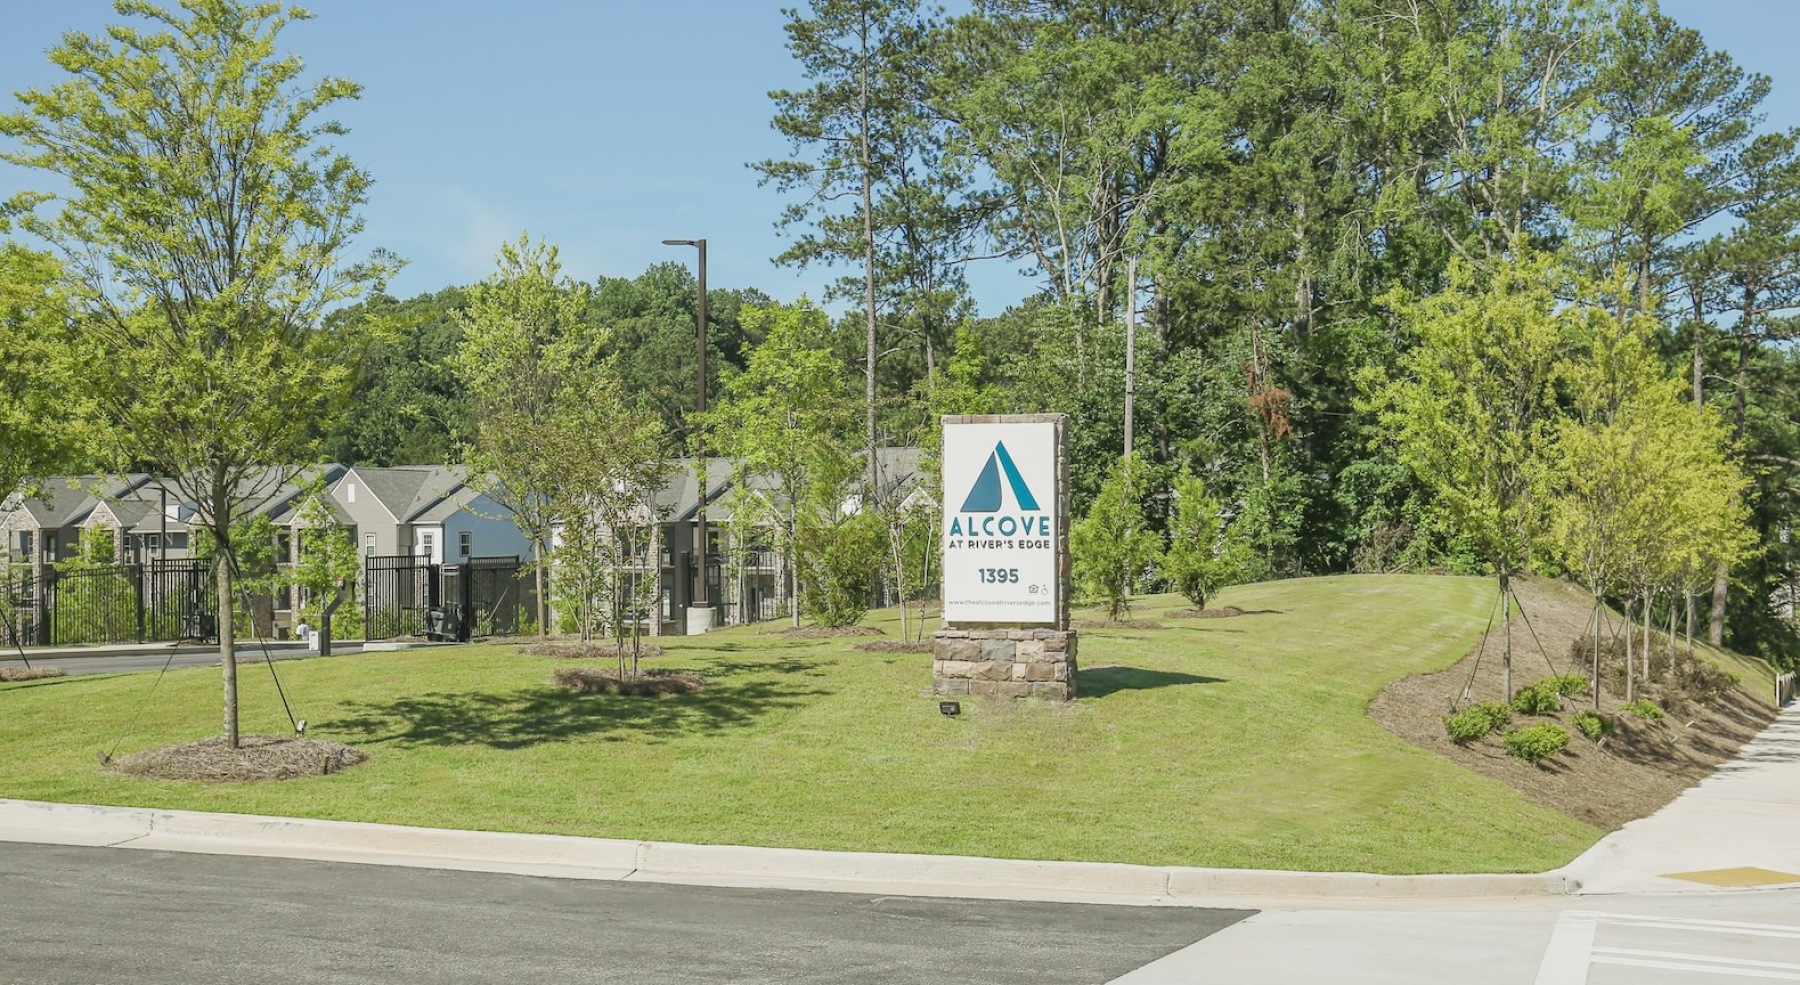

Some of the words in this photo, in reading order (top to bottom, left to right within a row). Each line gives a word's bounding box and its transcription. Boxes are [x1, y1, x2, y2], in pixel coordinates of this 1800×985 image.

[949, 516, 1050, 537] ALCOVE
[949, 540, 963, 549] AT
[968, 540, 1014, 549] RIVER'S
[1018, 540, 1050, 549] EDGE
[978, 568, 1019, 584] 1395
